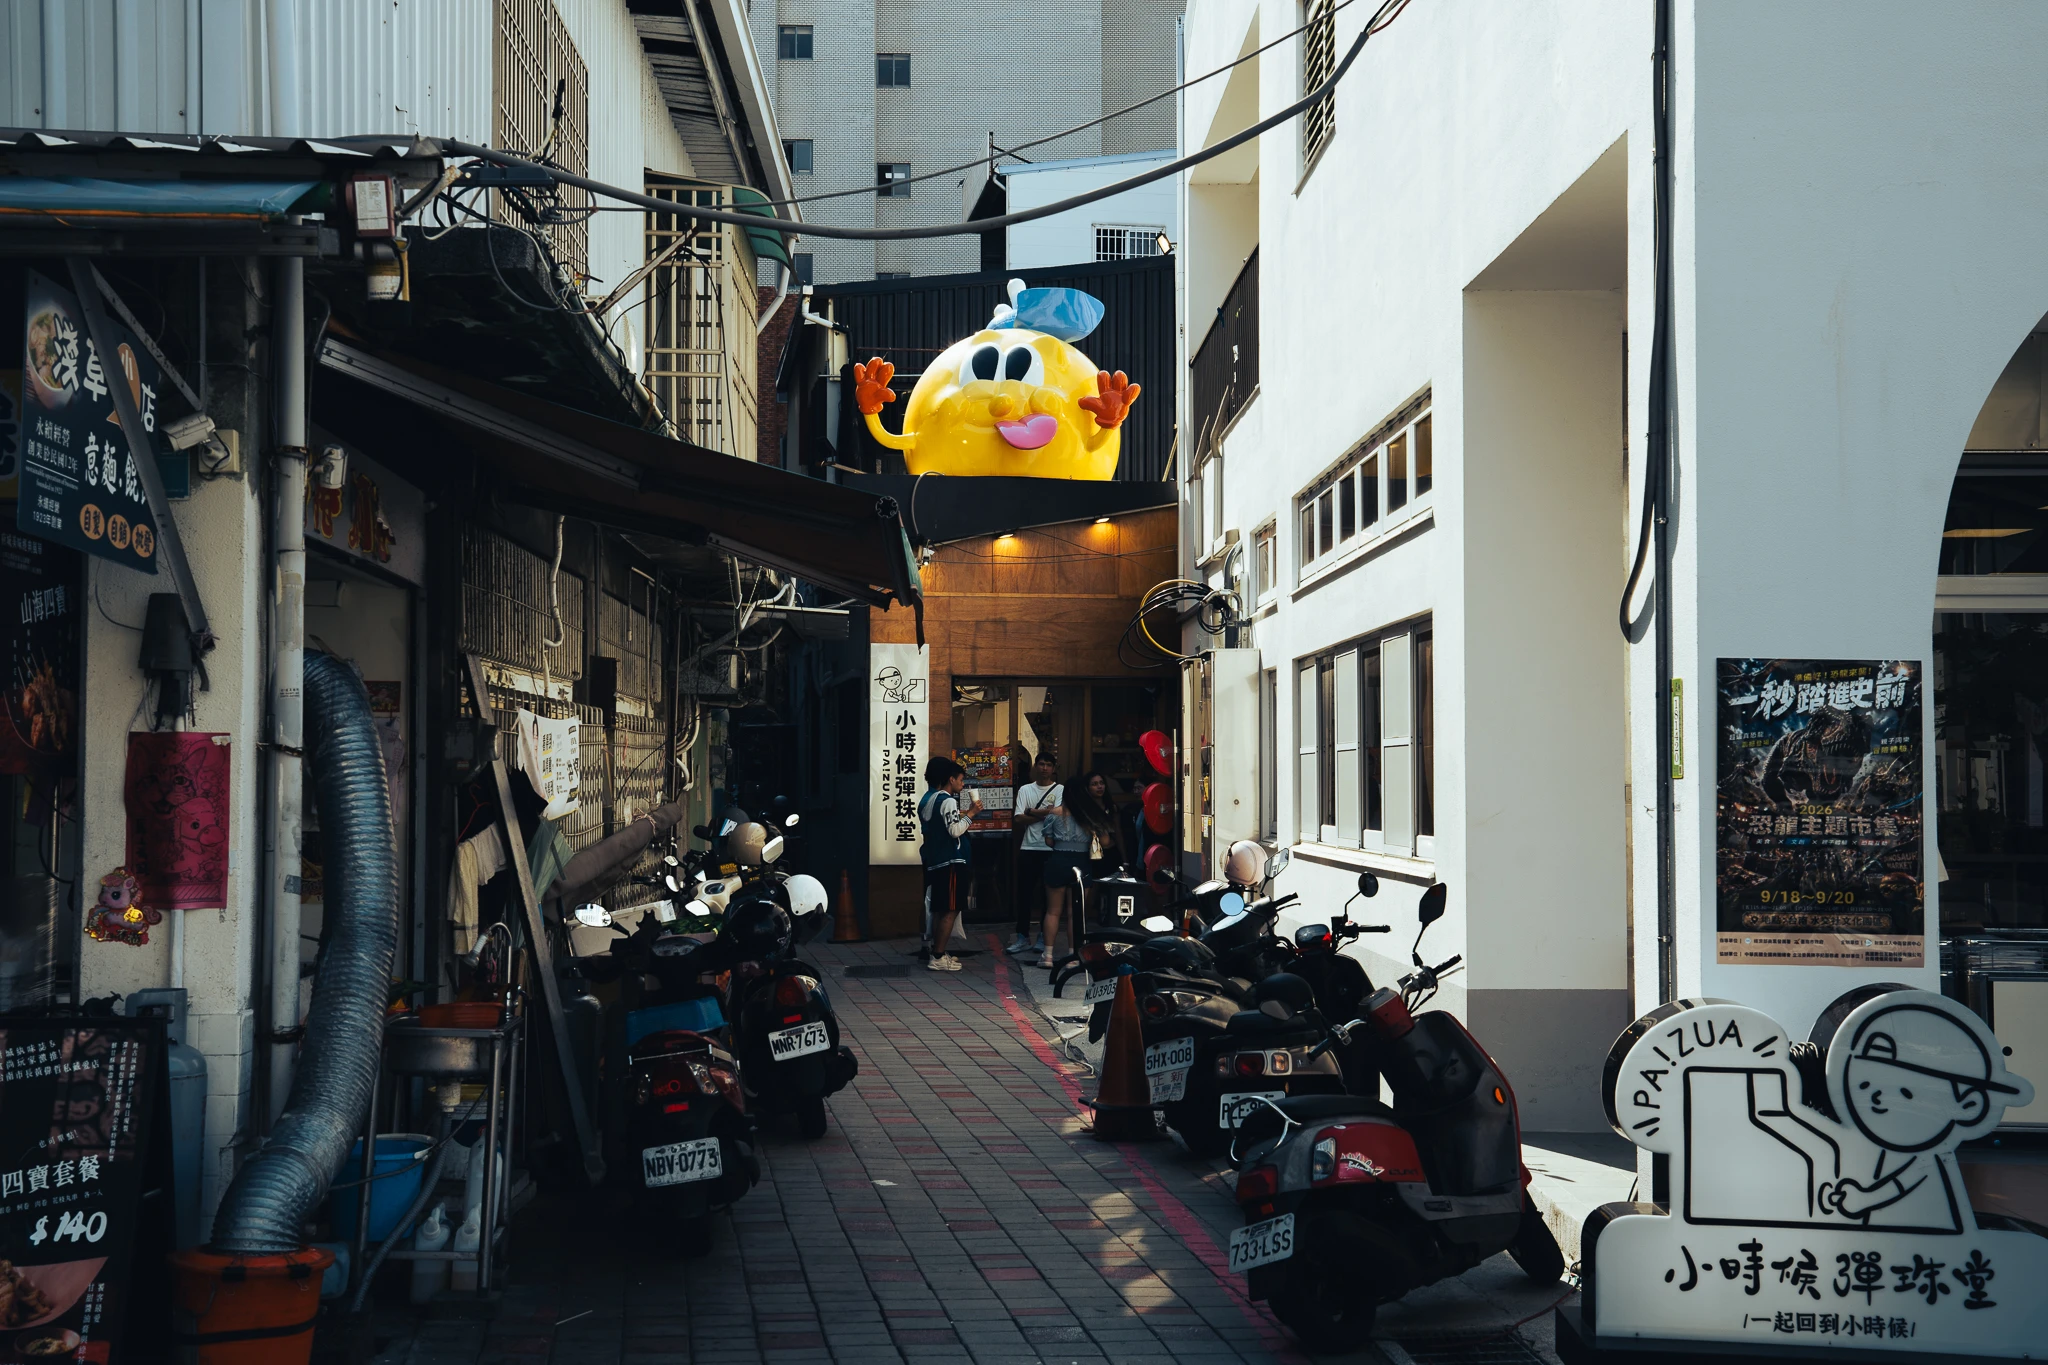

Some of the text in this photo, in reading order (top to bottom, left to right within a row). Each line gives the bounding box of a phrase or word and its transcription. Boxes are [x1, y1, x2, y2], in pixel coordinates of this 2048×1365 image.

[36, 416, 70, 448] 永續經營
[28, 438, 78, 474] 創業於民國12年
[84, 507, 100, 536] 自製
[111, 518, 127, 545] 自銷
[136, 528, 152, 554] 批發
[1728, 671, 1909, 720] 一秒踏進史前
[882, 750, 890, 802] PA!ZUA
[895, 710, 916, 842] 小時候彈珠堂
[1747, 814, 1900, 836] 恐龍主題市集
[1799, 805, 1833, 814] 2026
[772, 1029, 826, 1055] MNR-7673
[1146, 1047, 1192, 1070] 5HX-008
[1634, 1019, 1743, 1109] PA!ZUA
[2, 1154, 100, 1198] 四寶套餐
[646, 1148, 718, 1178] NBV-0773
[1232, 1230, 1291, 1266] 733-LSS
[1664, 1237, 1997, 1310] 小時候彈珠堂
